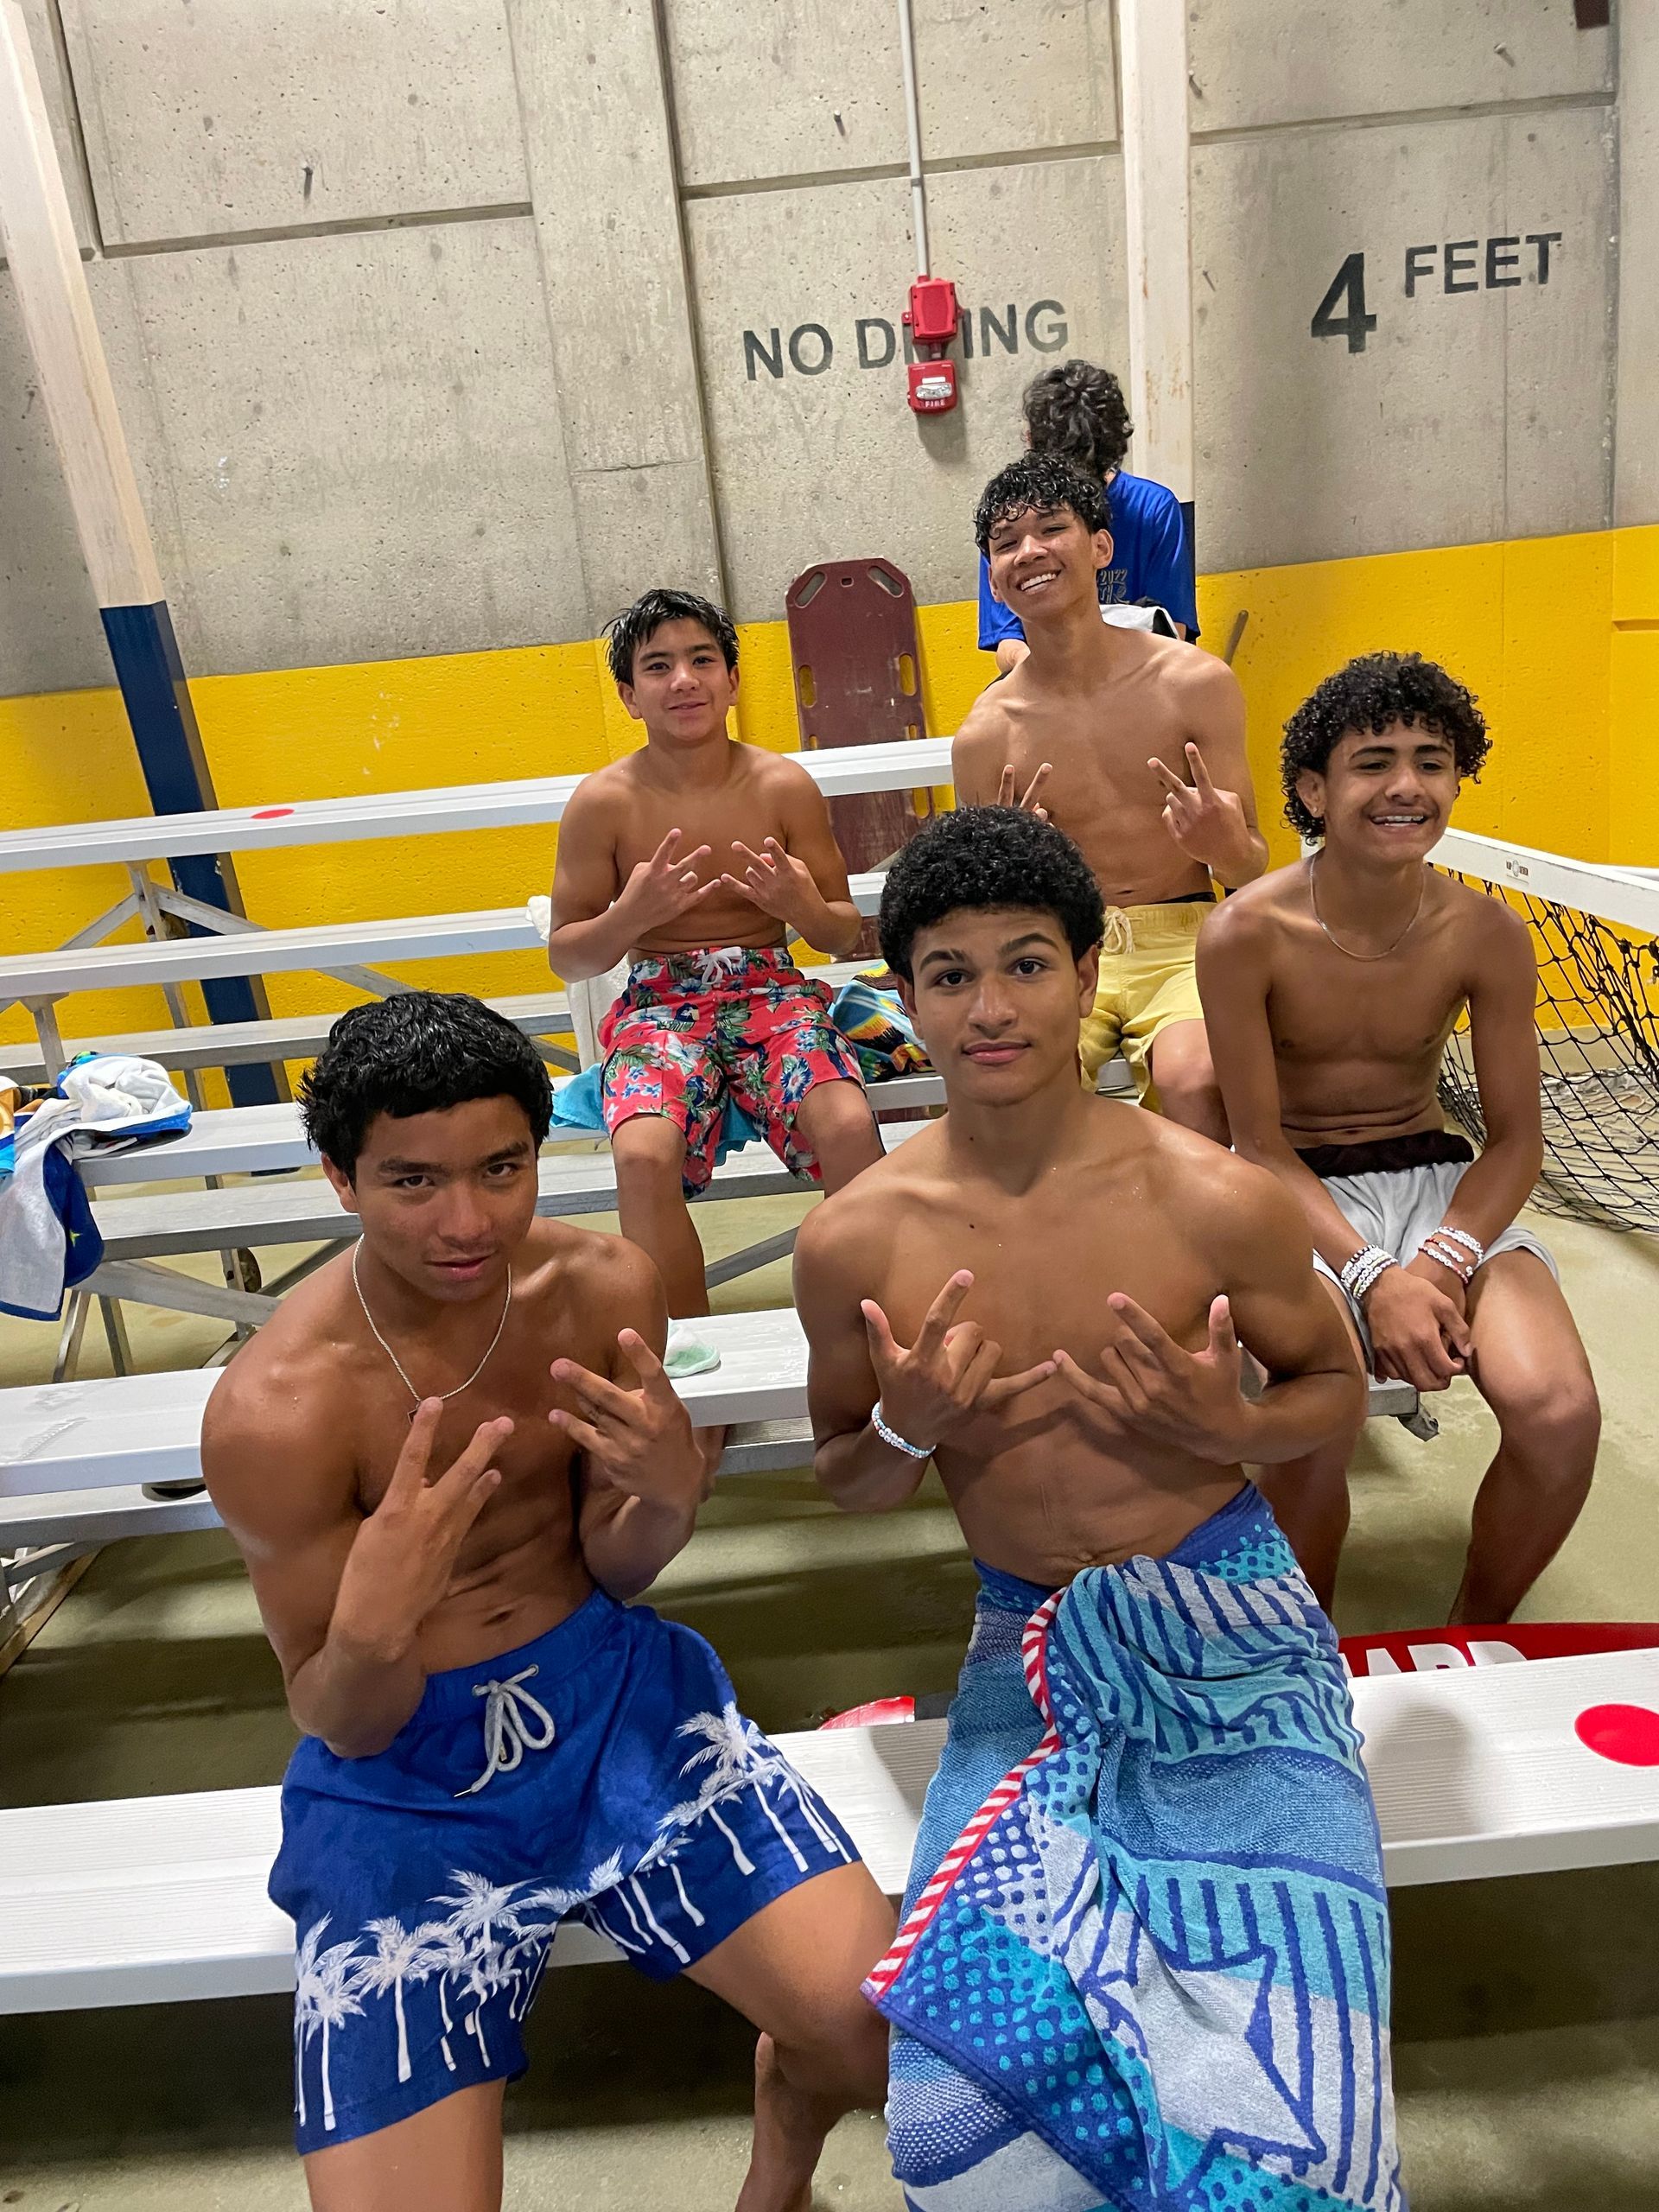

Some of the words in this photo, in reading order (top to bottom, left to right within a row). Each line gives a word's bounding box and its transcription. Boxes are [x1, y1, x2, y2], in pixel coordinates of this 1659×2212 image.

[1310, 252, 1377, 354] 4
[1404, 232, 1562, 298] FEET
[742, 322, 833, 381] NO
[855, 299, 1069, 370] DIING
[925, 399, 946, 408] FIRE
